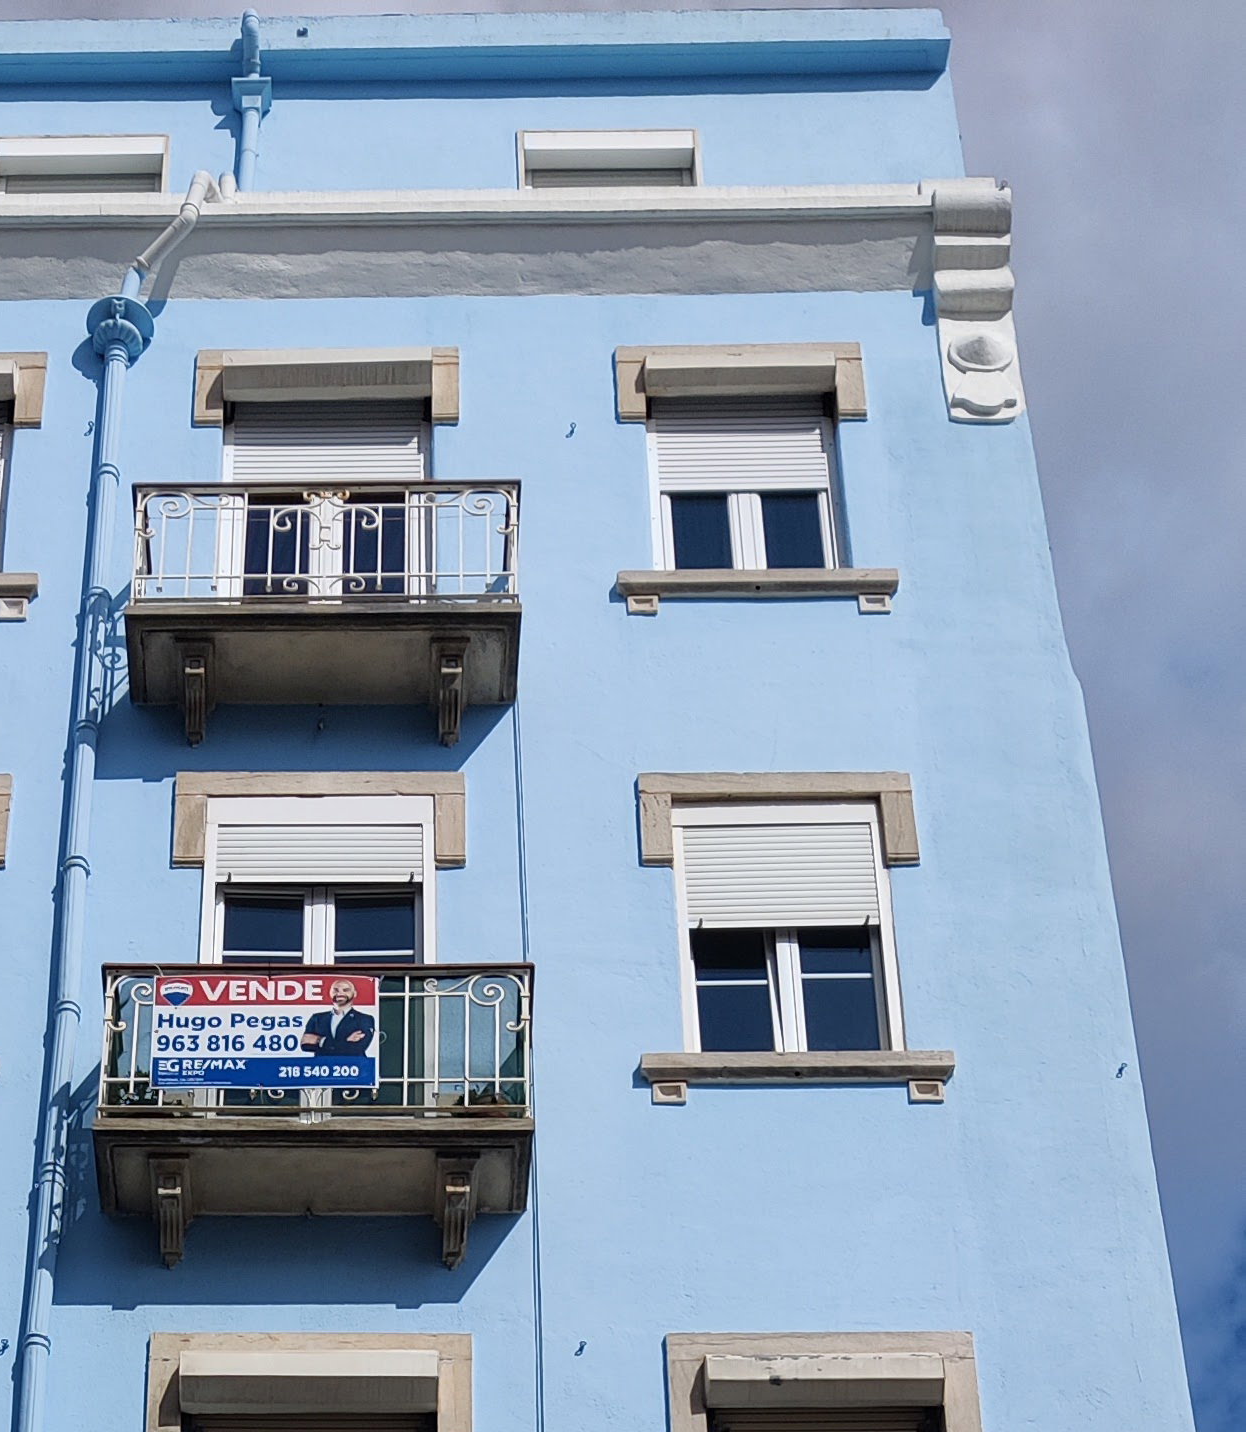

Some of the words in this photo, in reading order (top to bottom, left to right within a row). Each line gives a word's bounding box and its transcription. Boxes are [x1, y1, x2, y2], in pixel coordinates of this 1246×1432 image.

[199, 979, 324, 1002] VENDE
[157, 1013, 222, 1031] Hugo
[230, 1013, 303, 1031] Pegas
[156, 1034, 200, 1052] 963
[207, 1034, 245, 1052] 816
[252, 1034, 299, 1052] 480
[182, 1059, 247, 1071] RE/MAX
[278, 1065, 301, 1078] 218
[304, 1065, 330, 1078] 540
[332, 1065, 360, 1078] 200
